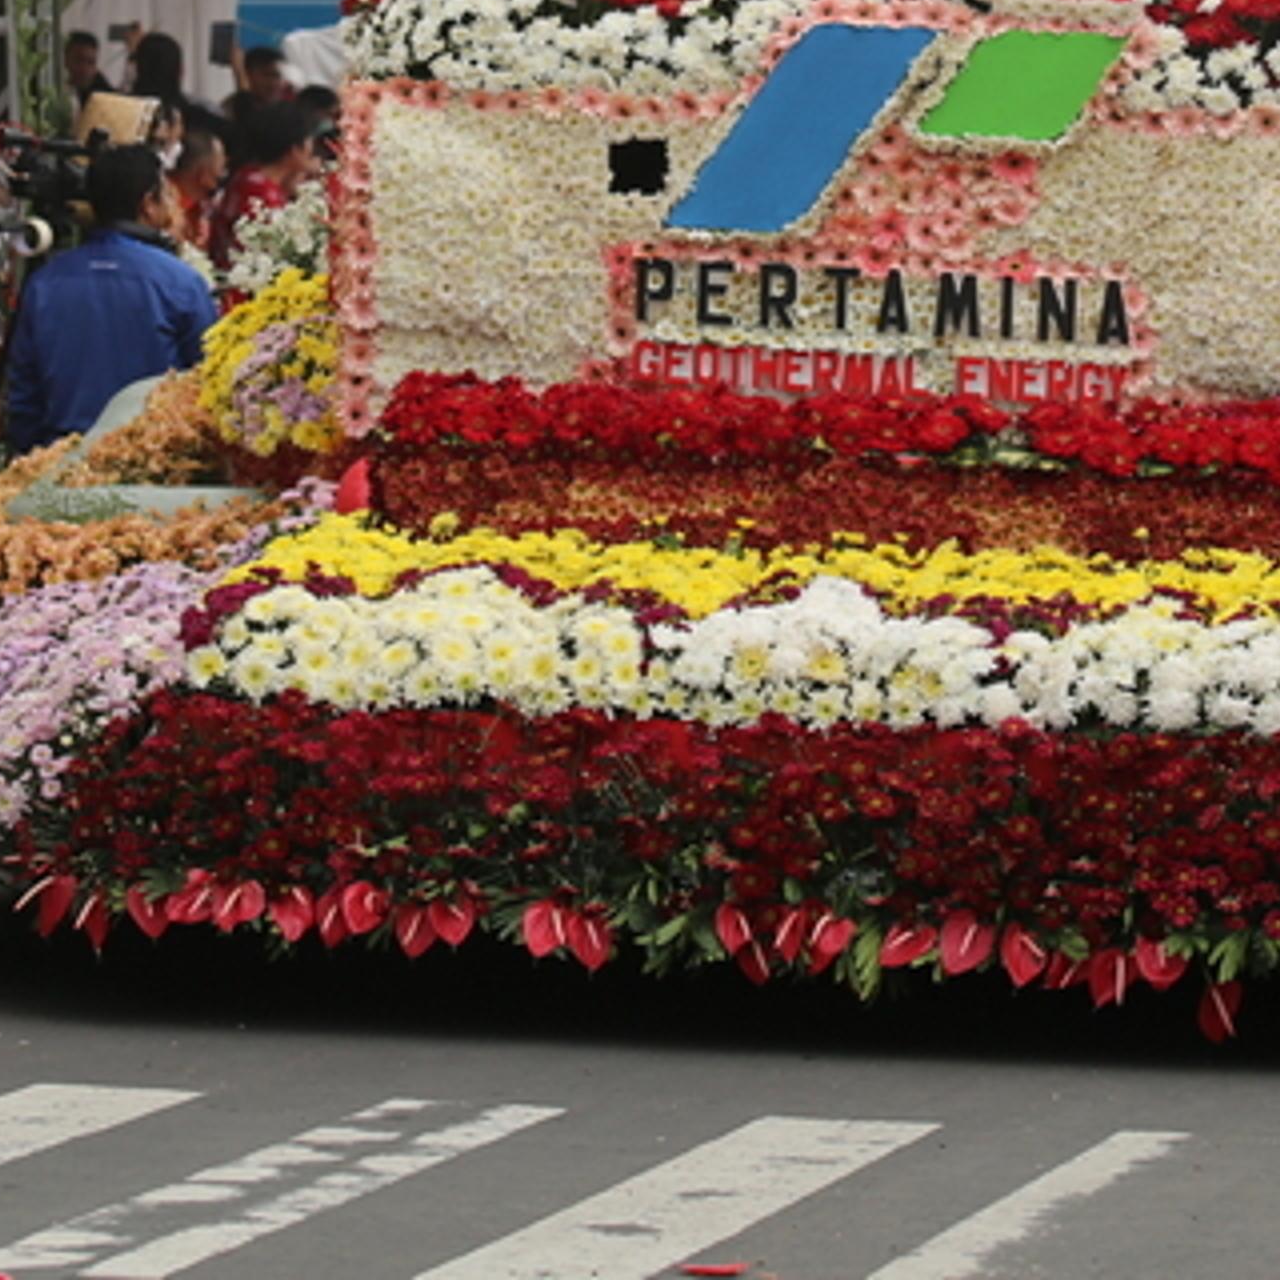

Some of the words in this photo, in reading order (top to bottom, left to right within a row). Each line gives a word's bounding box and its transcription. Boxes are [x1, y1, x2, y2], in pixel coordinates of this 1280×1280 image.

[634, 258, 1130, 346] PERTAMINA
[633, 340, 936, 398] GEOTHERMAL
[957, 356, 1129, 403] ENERGY
